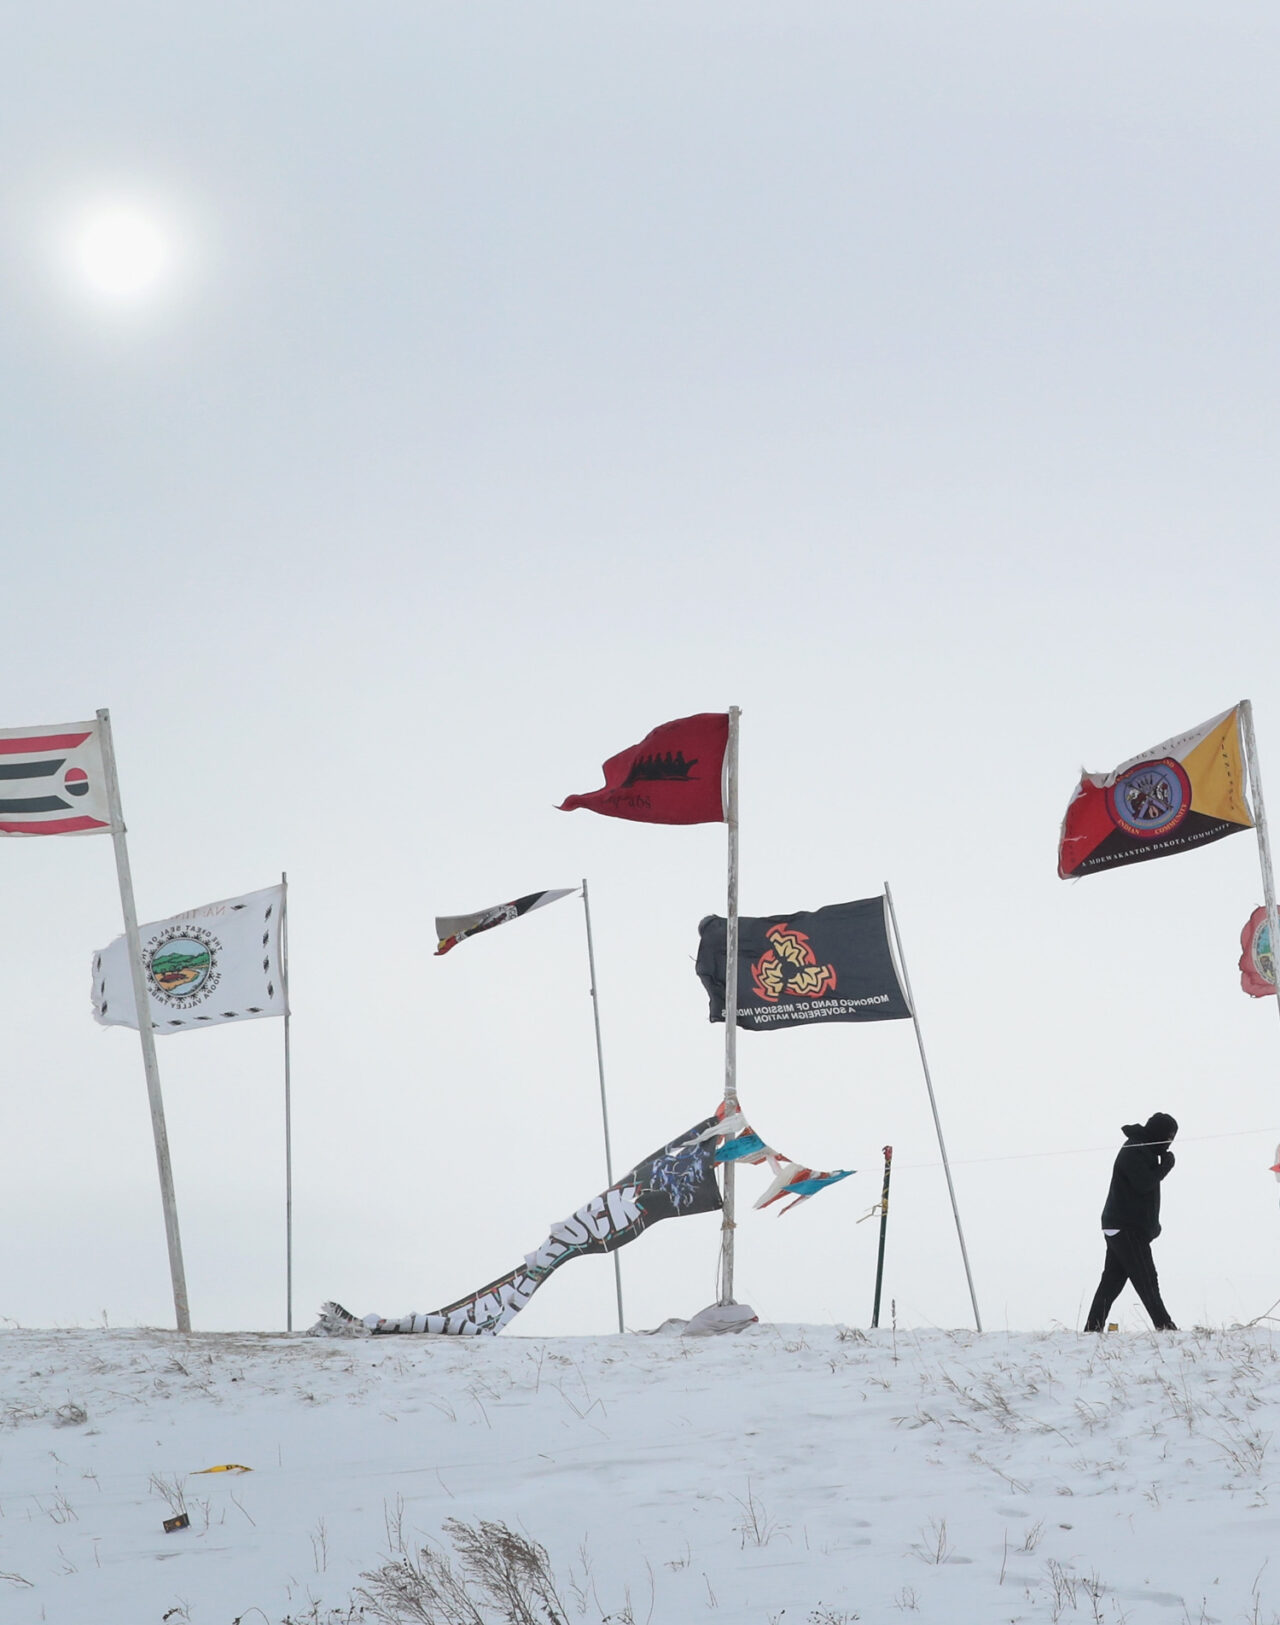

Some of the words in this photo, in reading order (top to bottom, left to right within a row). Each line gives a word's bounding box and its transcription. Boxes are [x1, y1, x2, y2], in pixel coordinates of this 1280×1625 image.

[1088, 846, 1151, 865] MDEWAKANTON
[1153, 838, 1186, 850] DAKOTA
[1187, 822, 1230, 842] COMMUNITY
